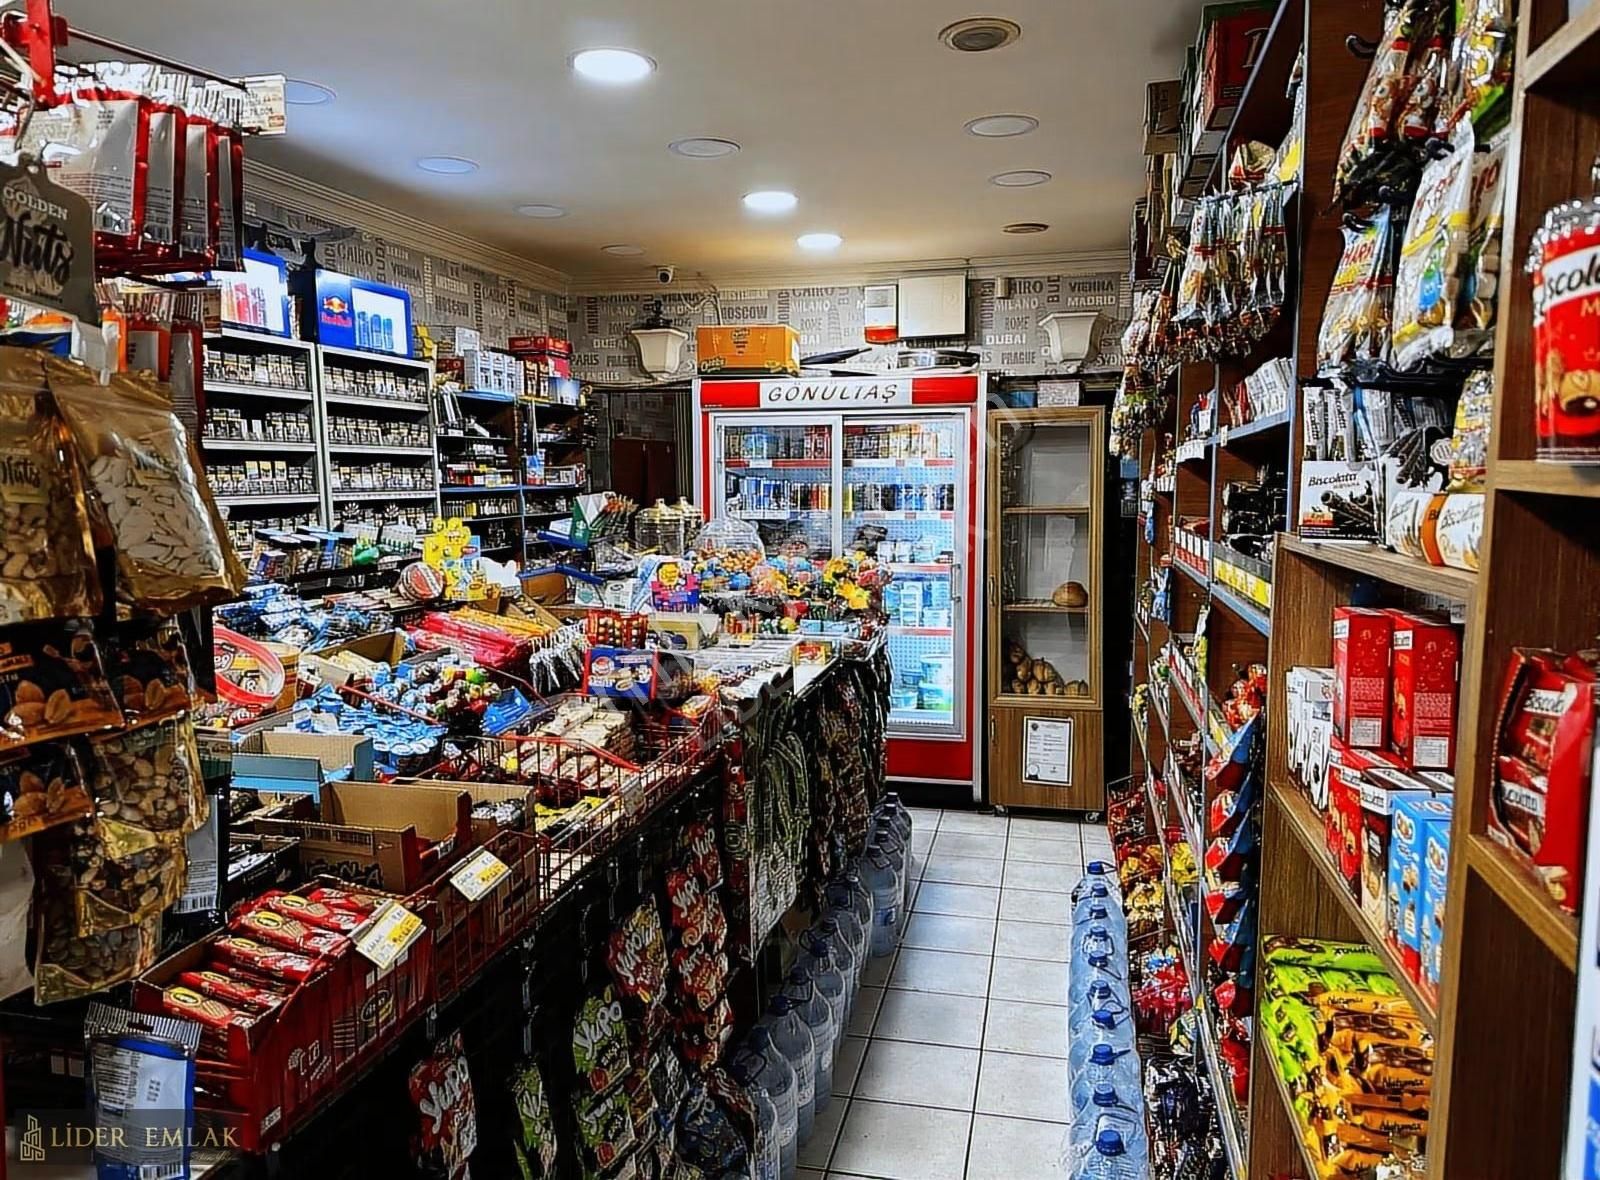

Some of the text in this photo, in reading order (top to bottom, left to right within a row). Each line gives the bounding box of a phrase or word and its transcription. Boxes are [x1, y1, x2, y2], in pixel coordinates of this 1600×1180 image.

[4, 186, 69, 220] GOLDEN
[0, 212, 75, 285] Nuts
[337, 243, 373, 267] CAIRO
[1068, 280, 1115, 296] VIENNA
[994, 298, 1038, 312] MILANO
[1067, 296, 1116, 308] MADRID
[985, 334, 1027, 346] DUBAI
[571, 354, 600, 367] PARIS
[575, 1001, 623, 1061] Yupo
[419, 1056, 470, 1135] Yupo
